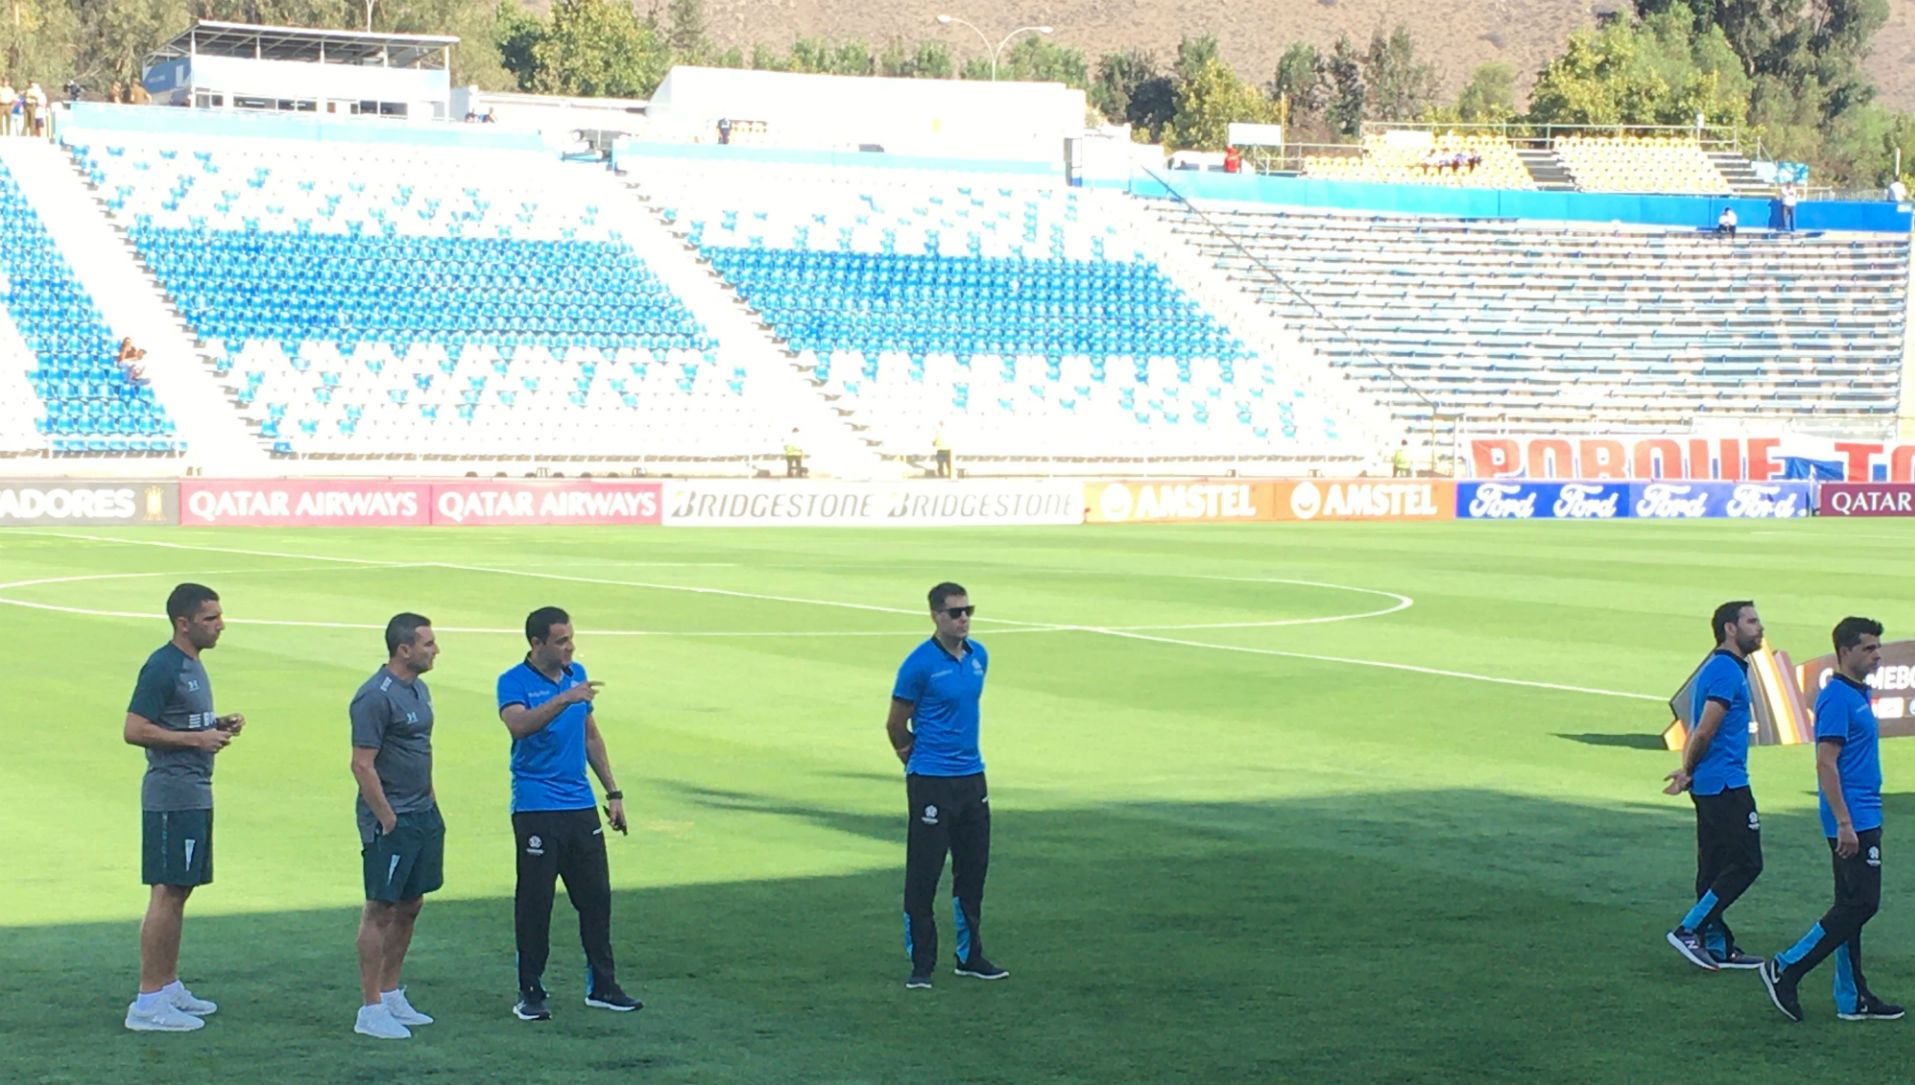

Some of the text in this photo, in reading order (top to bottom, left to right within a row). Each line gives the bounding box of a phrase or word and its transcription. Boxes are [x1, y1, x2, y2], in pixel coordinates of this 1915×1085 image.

[189, 490, 418, 522] QATAR AIRWAYS
[438, 490, 657, 522] QATAR AIRWAYS
[671, 490, 874, 518] BRIDGESTONE
[887, 490, 1073, 518] BRIDGESTONE
[1136, 484, 1257, 518] AMSTEL
[1323, 483, 1438, 516] AMSTEL
[1469, 483, 1537, 518] Ford
[1553, 483, 1619, 518] Ford
[1636, 483, 1709, 518] Ford
[1726, 483, 1798, 518] Ford
[1831, 490, 1912, 515] QATAR
